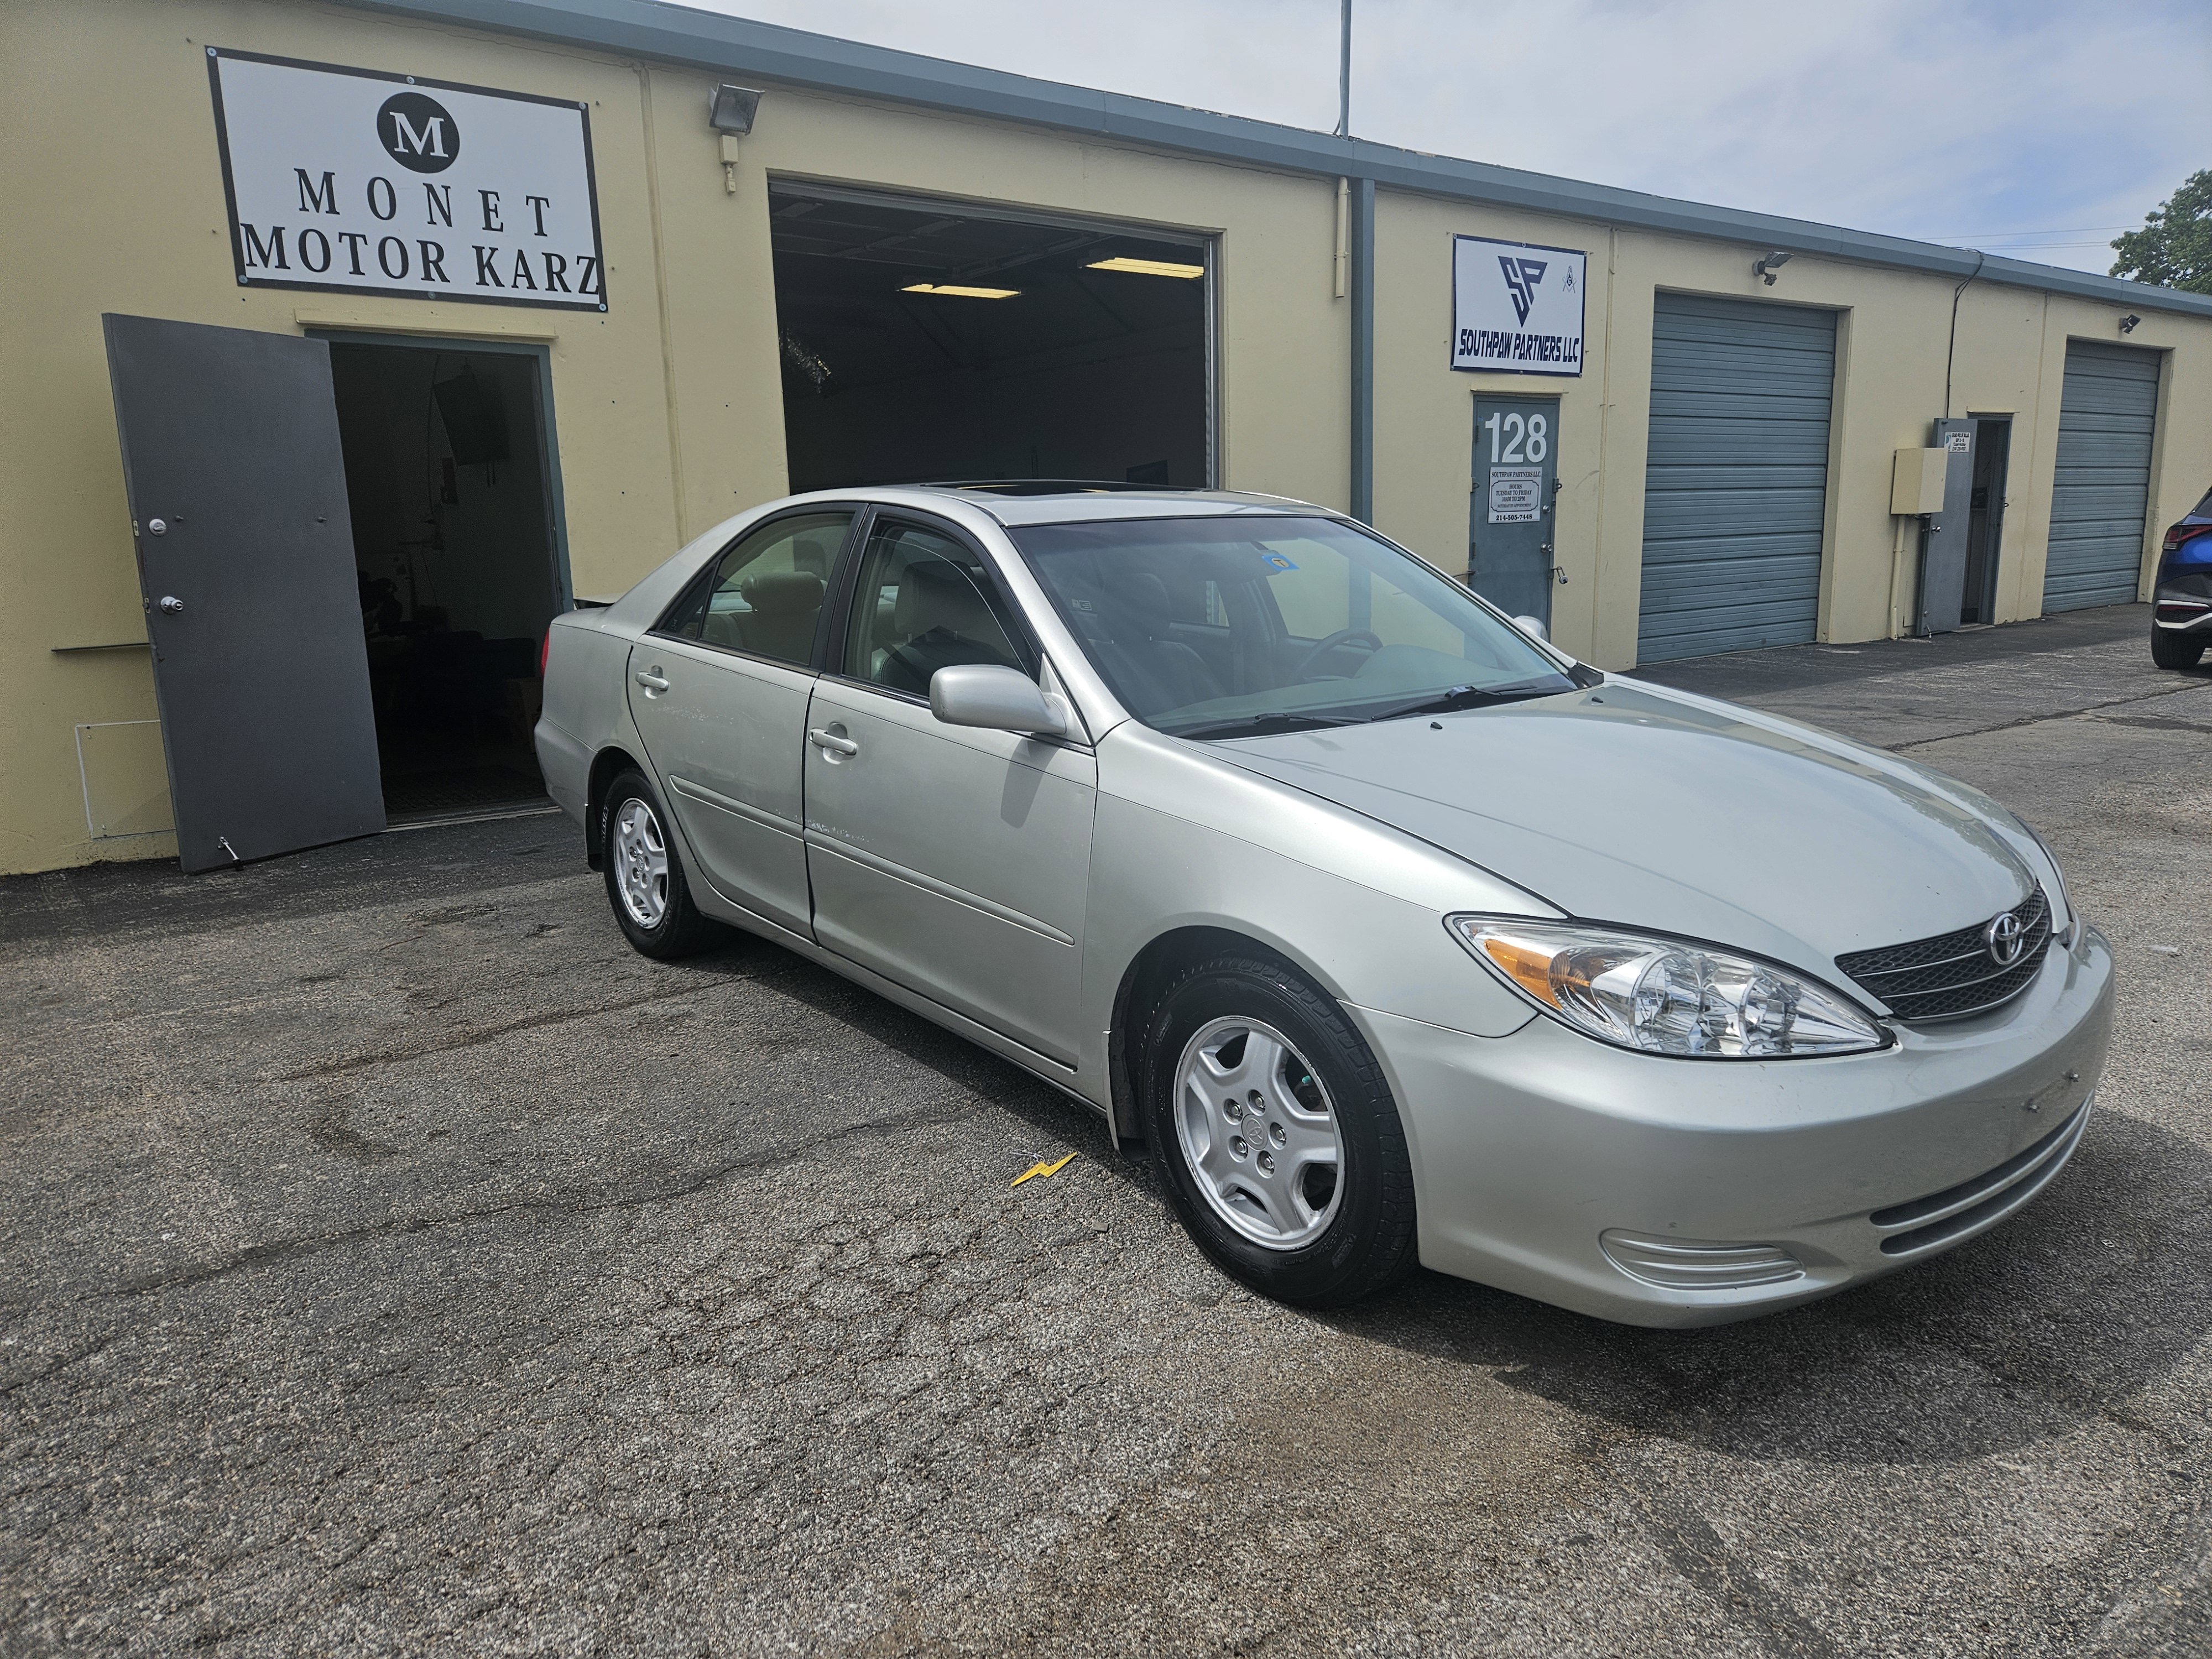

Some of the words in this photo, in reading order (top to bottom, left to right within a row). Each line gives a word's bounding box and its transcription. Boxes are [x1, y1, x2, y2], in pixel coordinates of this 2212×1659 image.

[389, 112, 449, 158] M
[294, 168, 550, 237] MONET
[240, 222, 451, 283] MOTOR
[472, 245, 598, 295] KARZ
[1498, 255, 1548, 328] SP
[1458, 328, 1513, 359] SOUTHPAW
[1512, 333, 1562, 362] PARTNERS
[1562, 337, 1579, 363] LLC
[1485, 413, 1547, 463] 128
